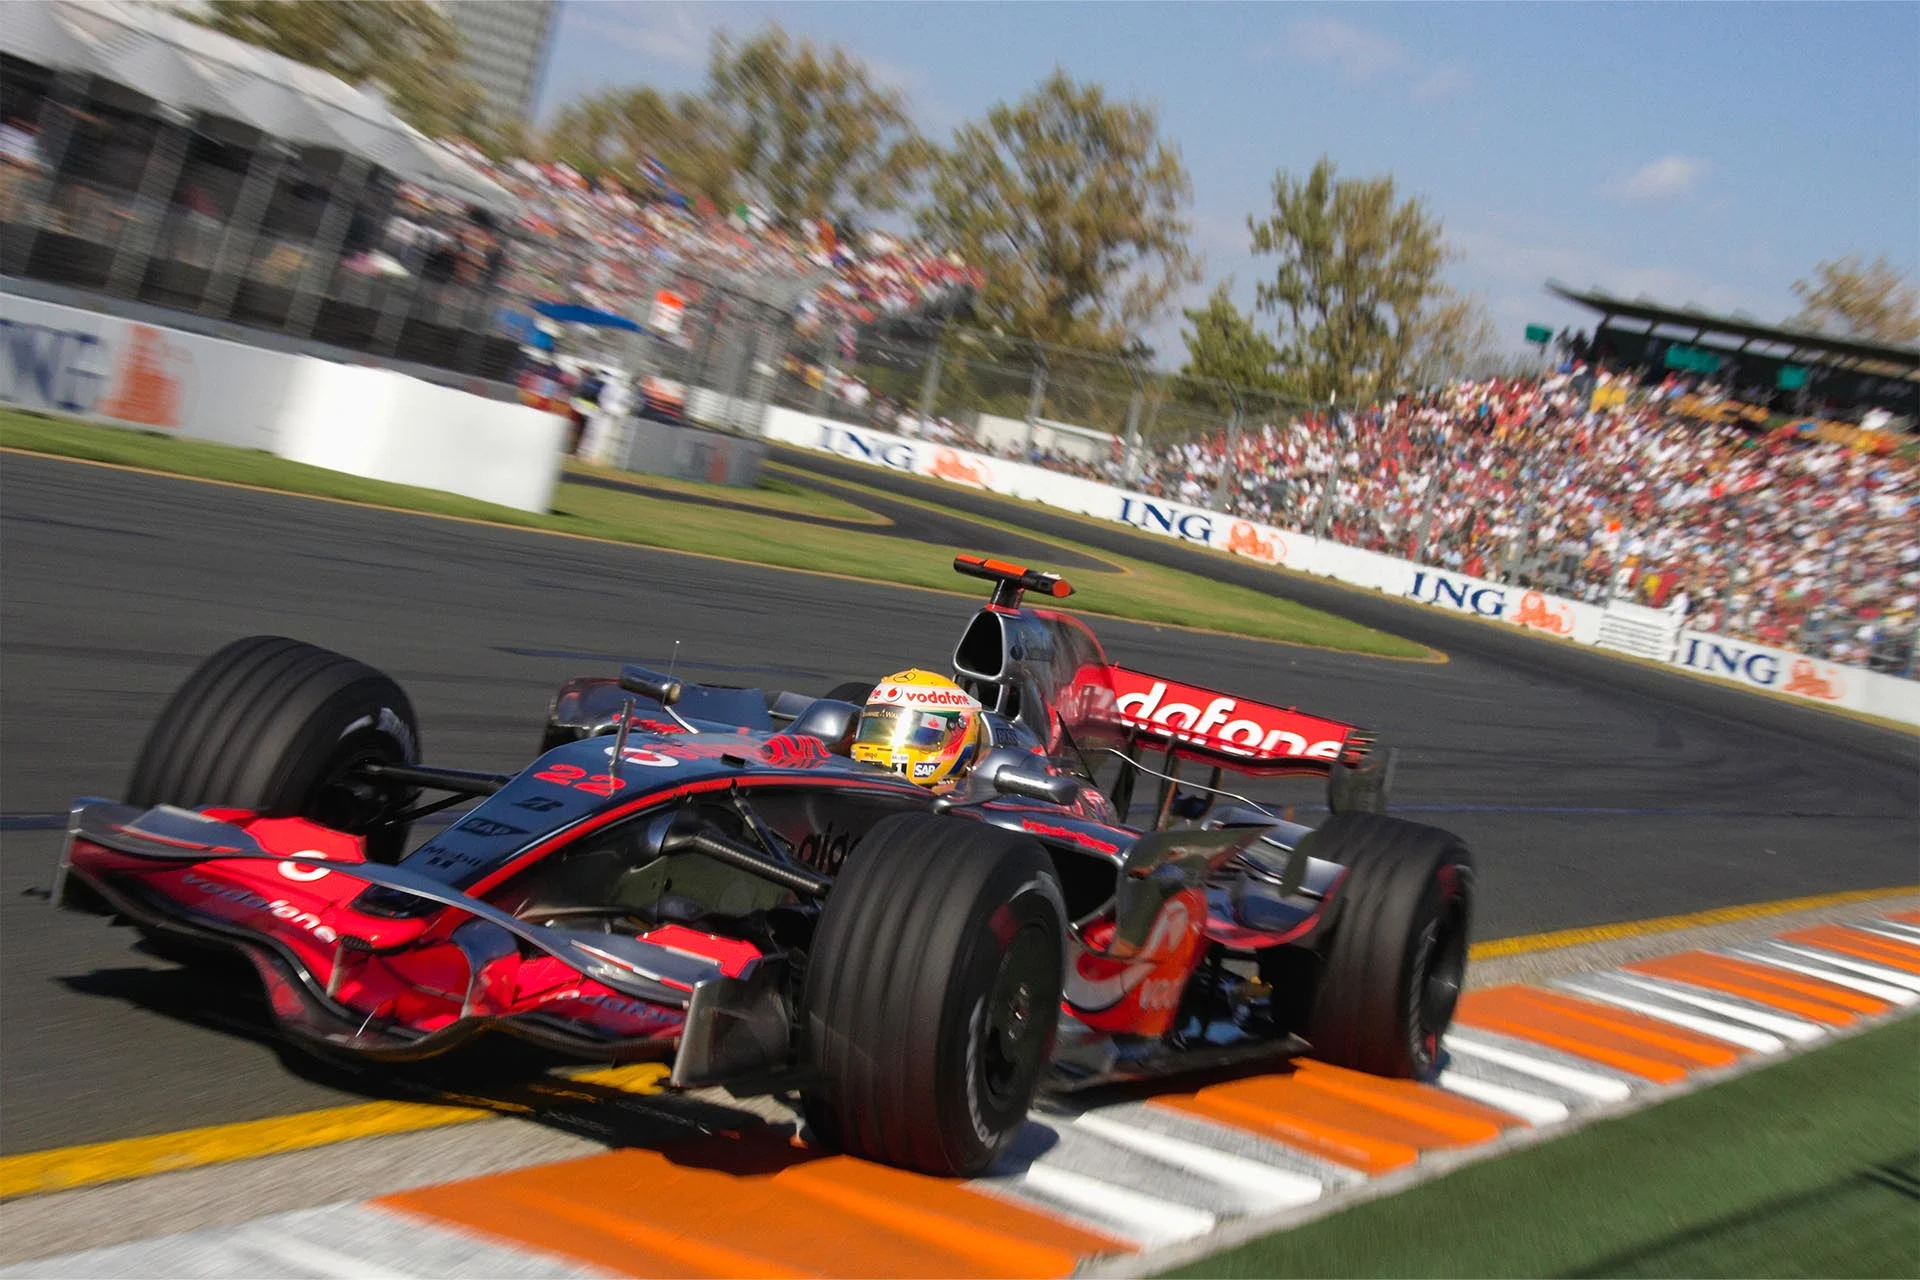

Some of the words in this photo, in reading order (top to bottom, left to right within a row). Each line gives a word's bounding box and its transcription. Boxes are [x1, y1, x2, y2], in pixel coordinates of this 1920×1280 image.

[820, 424, 917, 471] ING
[1120, 497, 1215, 543] ING
[1410, 571, 1508, 617] ING
[1683, 638, 1779, 685] ING
[905, 690, 971, 706] vodafone
[533, 764, 627, 799] 22
[914, 763, 936, 777] SAP
[182, 873, 338, 944] vodafone
